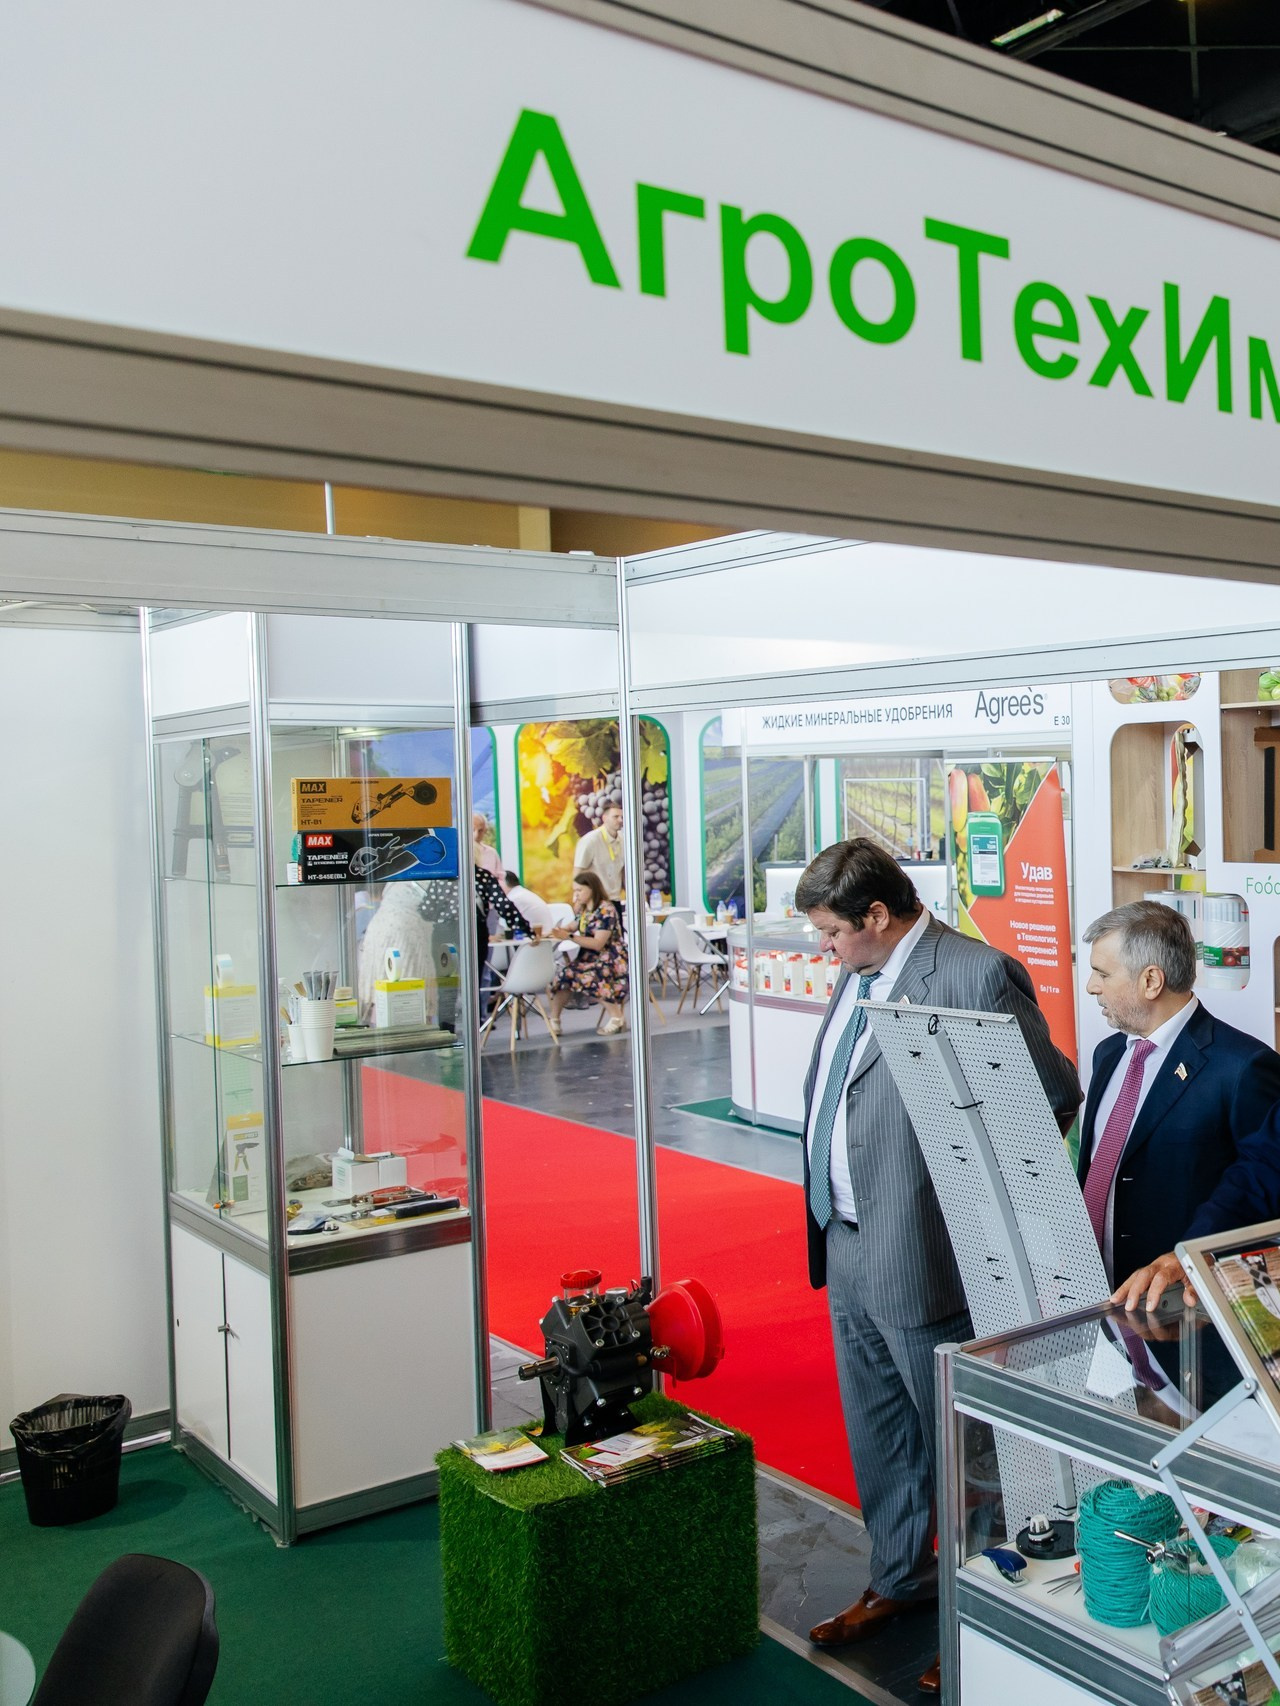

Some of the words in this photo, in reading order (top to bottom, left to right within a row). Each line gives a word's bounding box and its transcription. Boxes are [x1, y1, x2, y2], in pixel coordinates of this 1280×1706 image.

[762, 714, 803, 730] ЖИДКИЕ
[804, 708, 883, 727] МИНЕРАЛЬНЫЕ
[884, 703, 953, 723] УДОБРЕНИЯ
[1061, 716, 1070, 725] 30
[302, 783, 325, 793] MAX
[307, 836, 332, 846] MAX
[1020, 861, 1053, 883] Удав
